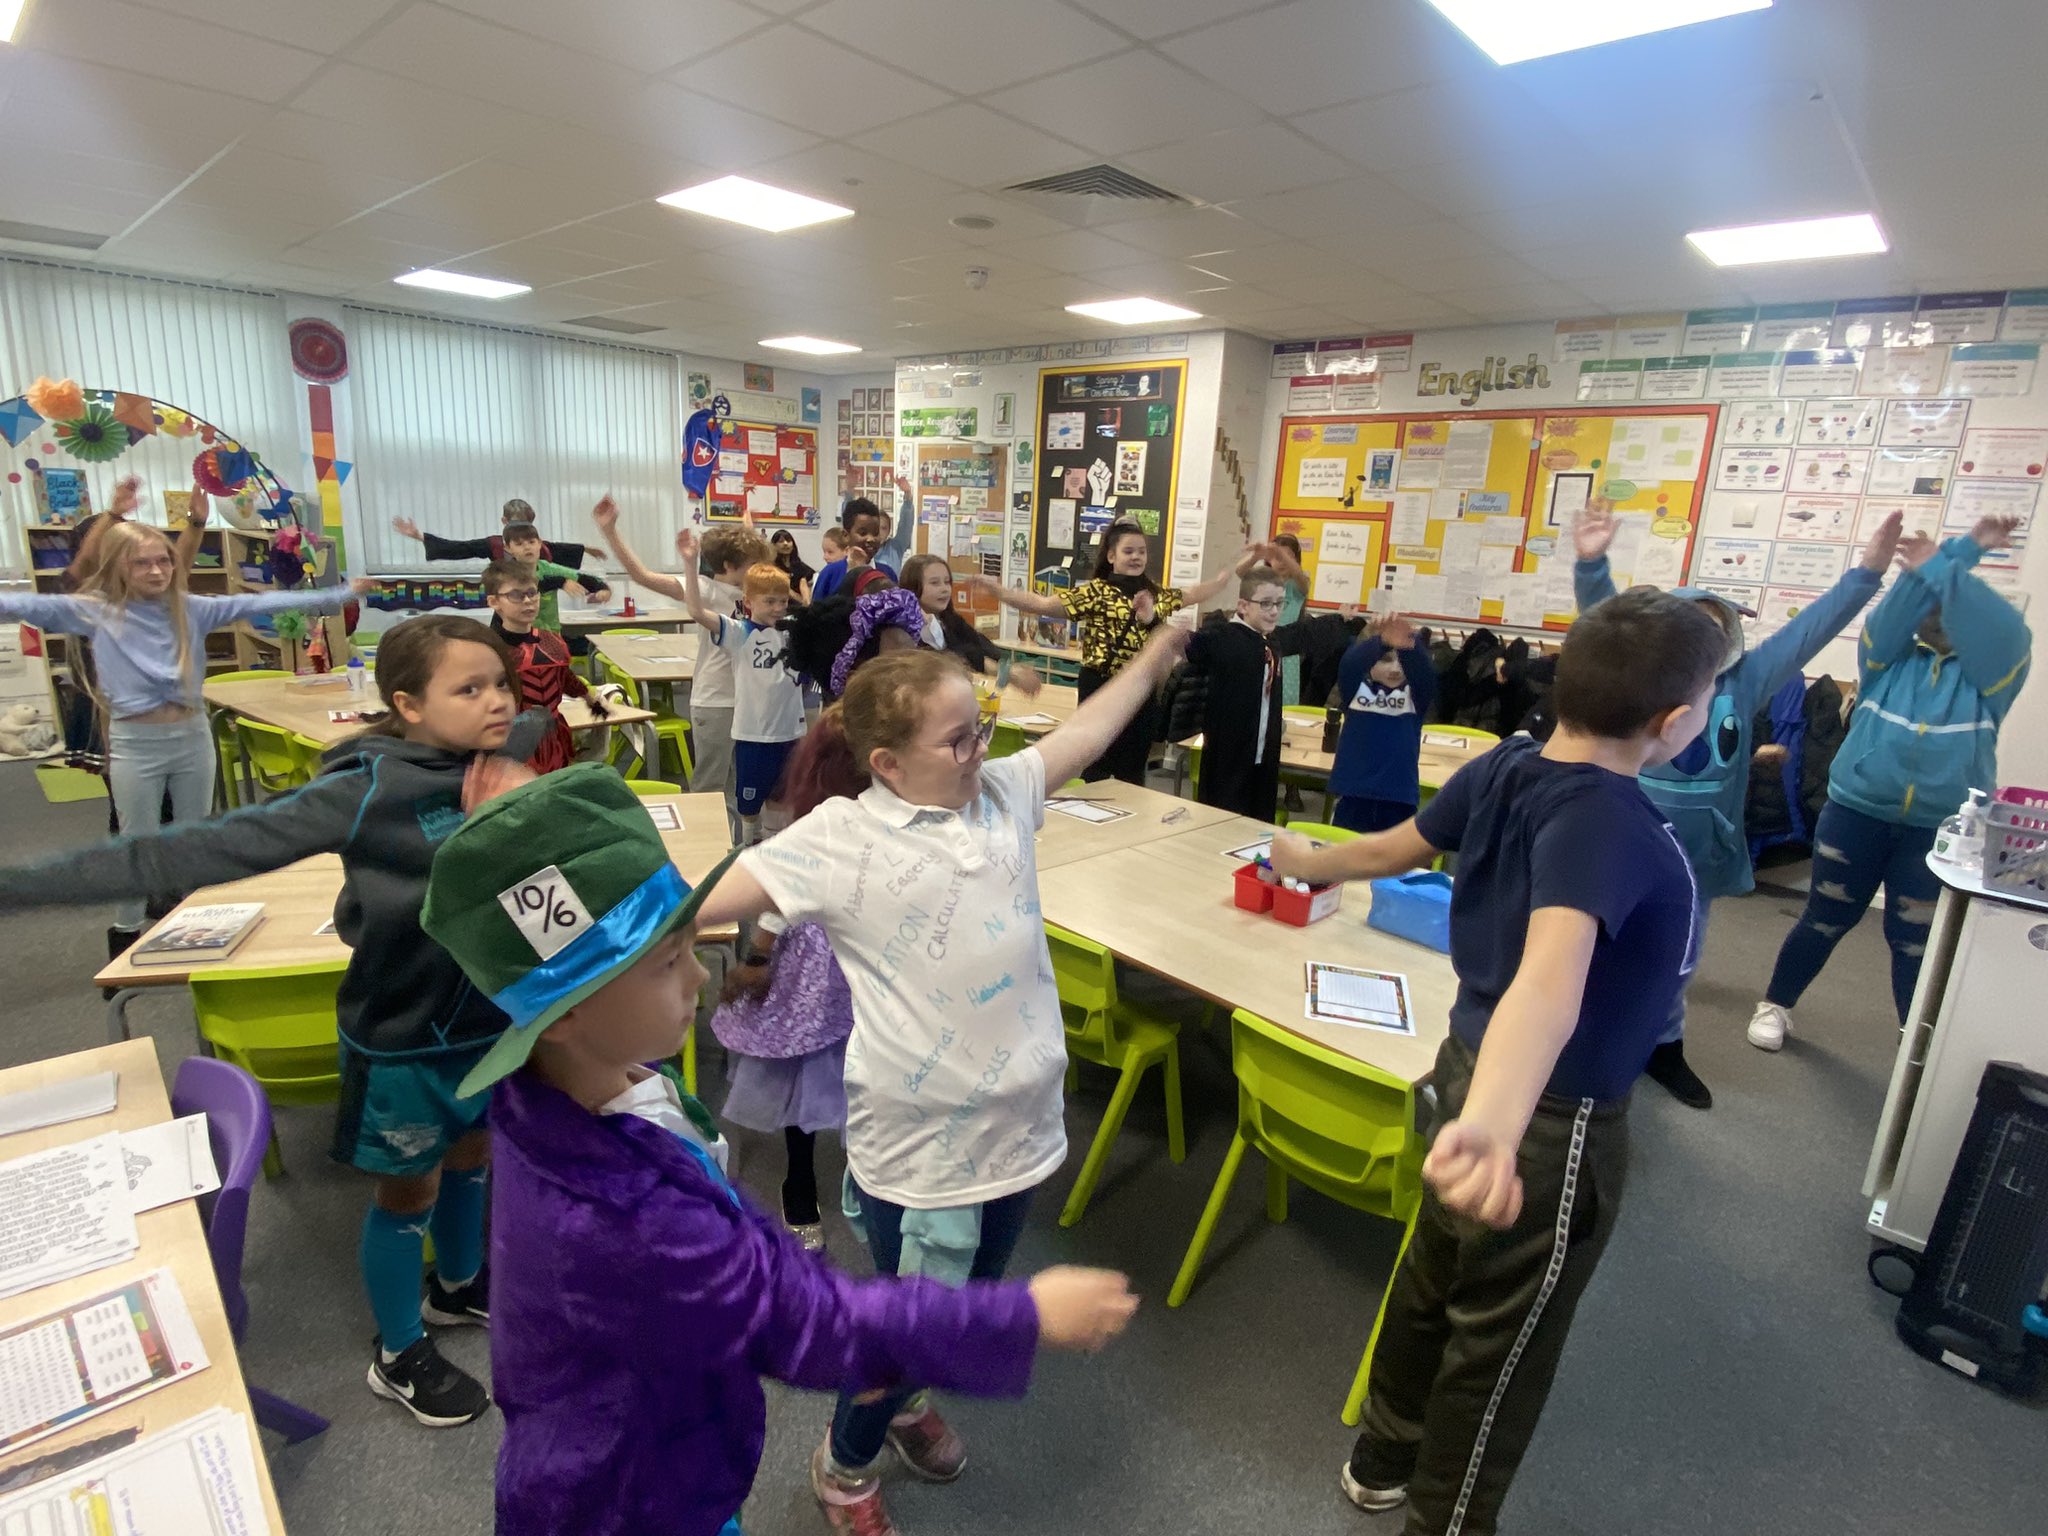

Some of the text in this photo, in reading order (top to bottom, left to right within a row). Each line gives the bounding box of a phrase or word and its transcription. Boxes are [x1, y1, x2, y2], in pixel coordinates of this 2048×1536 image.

[1096, 375, 1118, 386] Spring
[1417, 353, 1551, 406] English
[886, 850, 942, 897] Eagerly
[512, 885, 577, 934] 10/6
[927, 866, 969, 960] CALCULATE
[903, 1026, 955, 1093] Bacterial
